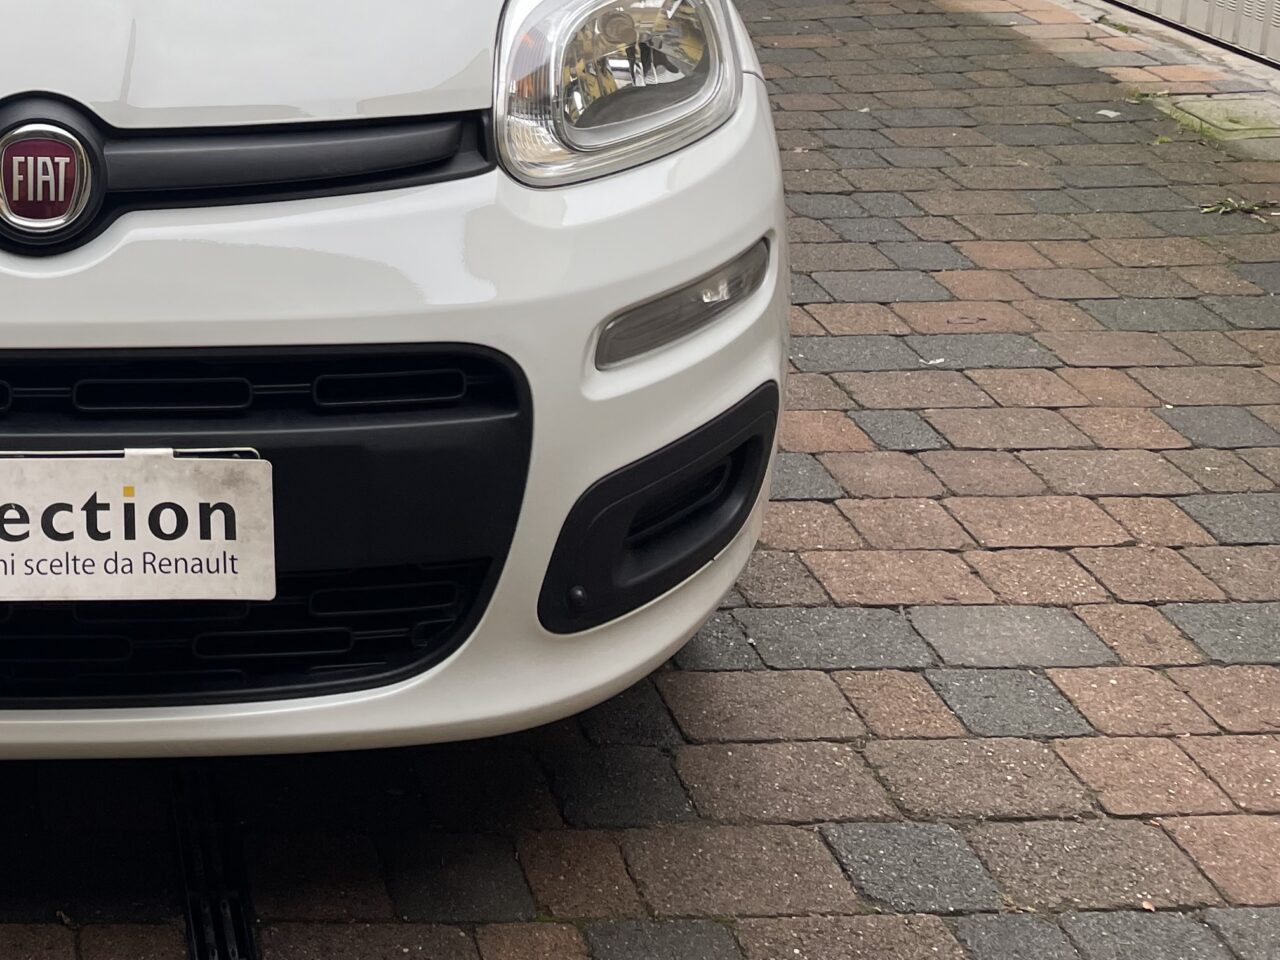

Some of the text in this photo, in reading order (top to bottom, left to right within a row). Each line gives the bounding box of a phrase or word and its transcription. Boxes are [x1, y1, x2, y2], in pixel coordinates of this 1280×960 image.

[12, 156, 70, 202] FIAT
[24, 551, 95, 576] scelte
[103, 551, 134, 575] da
[142, 550, 239, 575] Renault
